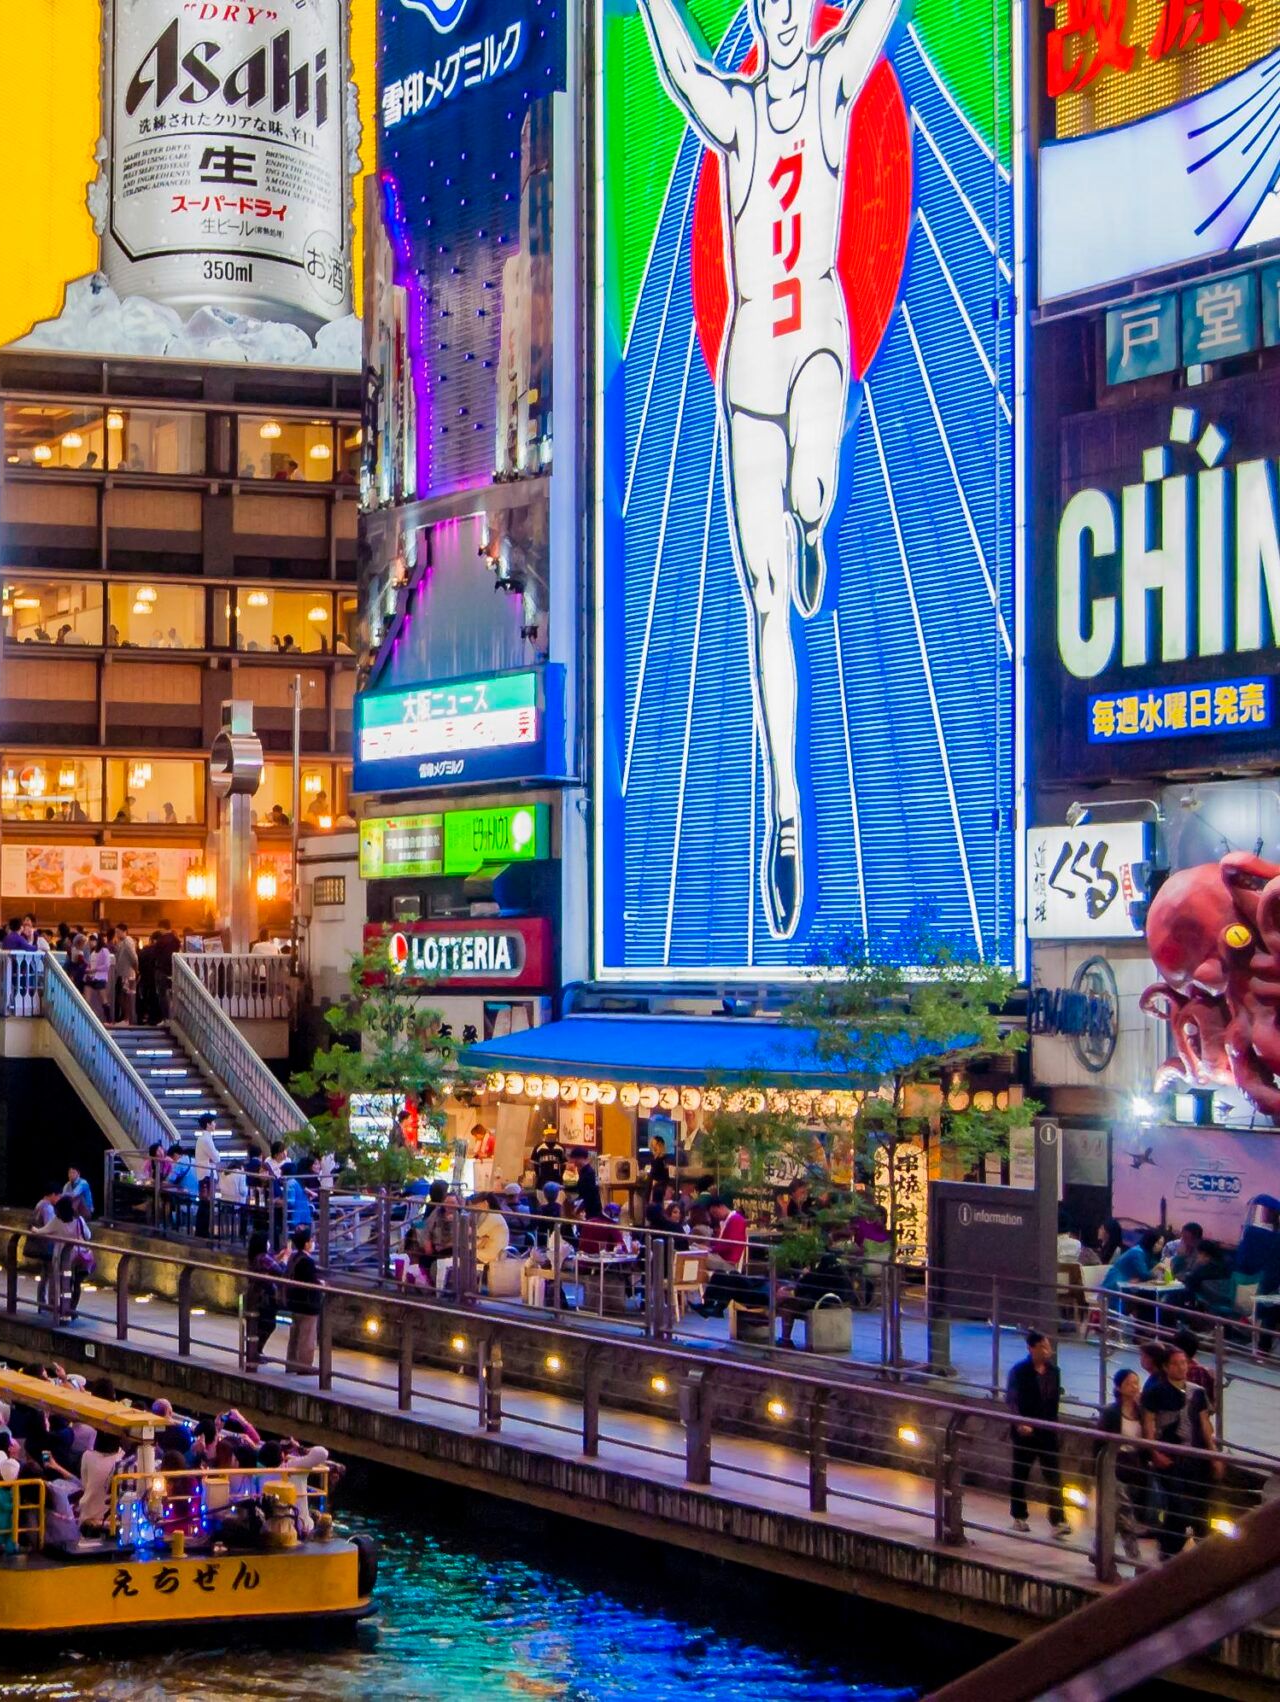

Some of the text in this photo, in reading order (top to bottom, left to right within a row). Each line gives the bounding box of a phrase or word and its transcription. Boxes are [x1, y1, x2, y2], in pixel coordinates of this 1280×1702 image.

[125, 16, 329, 128] Asahi
[382, 20, 521, 128] 雪印メグミルク
[199, 145, 258, 187] 生
[171, 195, 287, 221] スーパードライ
[768, 138, 805, 338] グリコ
[203, 260, 253, 283] 350ml
[307, 246, 344, 295] お酒
[1120, 281, 1280, 367] 戸堂
[403, 684, 488, 723] 大阪ニュース
[1093, 683, 1265, 737] 毎週水曜日発売
[1048, 841, 1118, 919] くくる
[412, 935, 512, 971] LOTTERIA
[973, 1209, 1023, 1226] information
[112, 1562, 260, 1598] えちぜん
